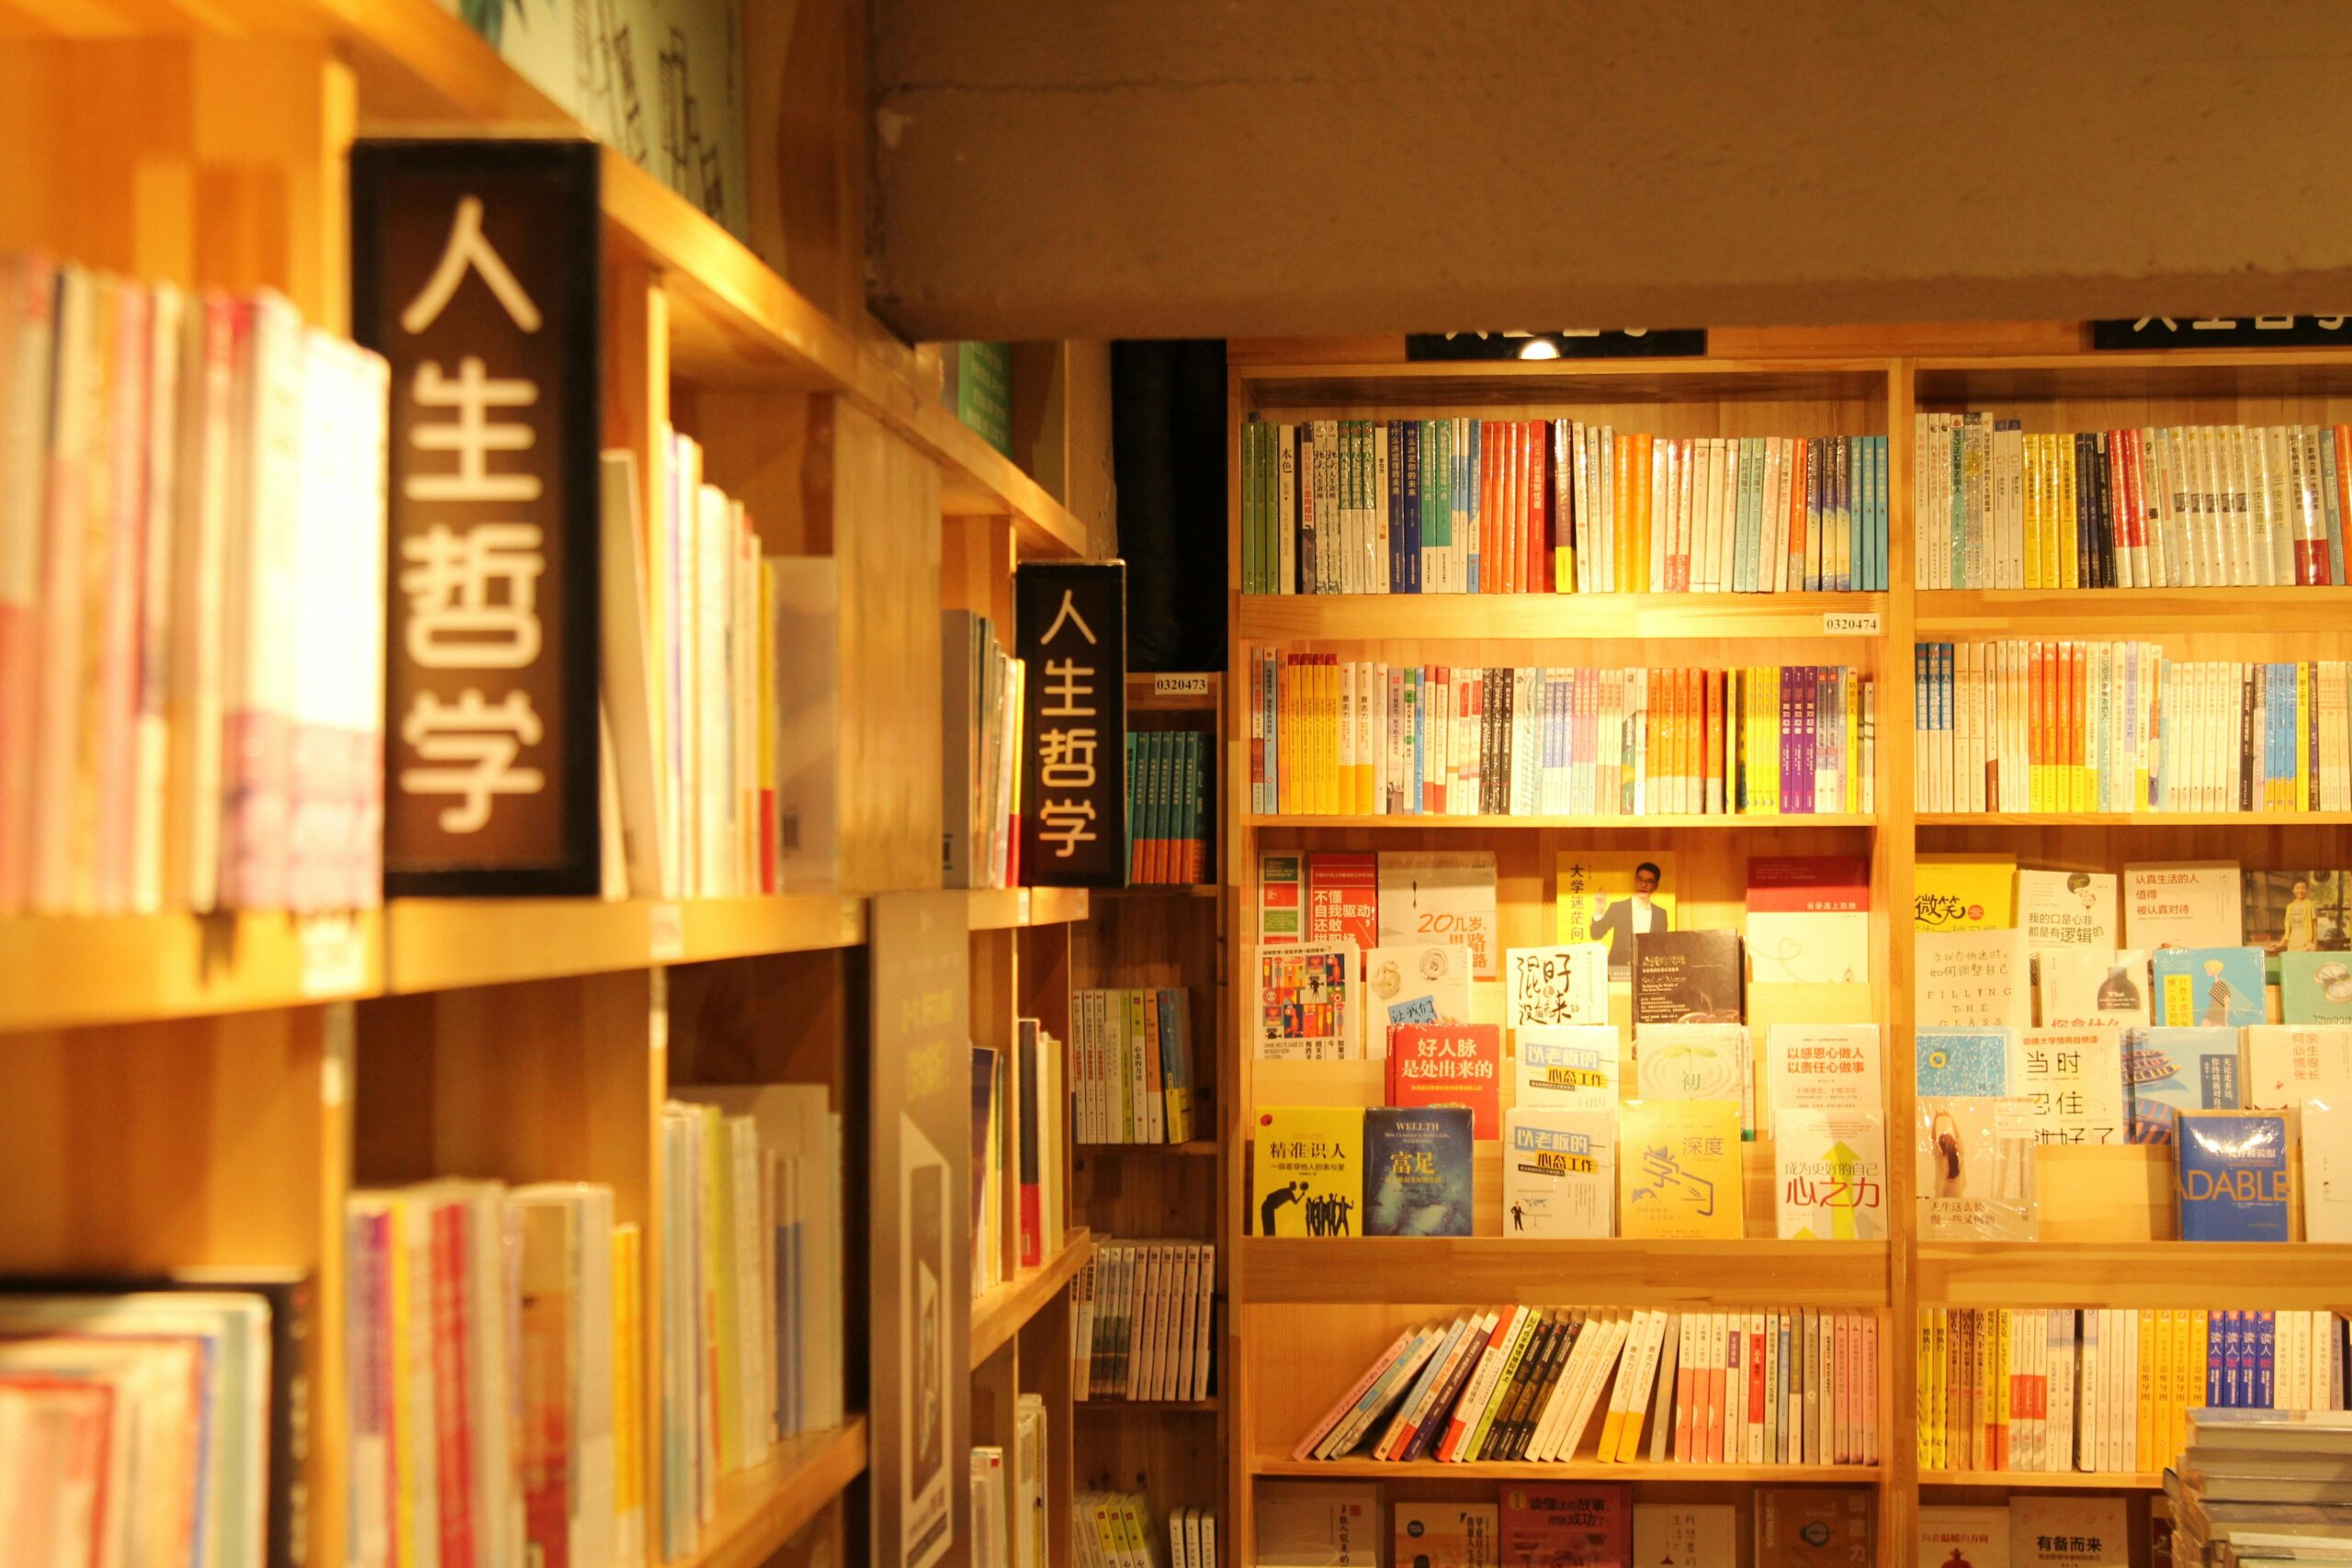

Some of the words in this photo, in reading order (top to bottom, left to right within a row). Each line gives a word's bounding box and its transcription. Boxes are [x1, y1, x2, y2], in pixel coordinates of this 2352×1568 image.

[1282, 448, 1293, 474] 本色
[401, 194, 544, 833] 人生哲学
[1826, 618, 1877, 631] 0320474
[1157, 679, 1206, 691] 0320473
[1039, 589, 1097, 858] 人生哲学
[2136, 874, 2199, 885] 认真生活的人
[1314, 890, 1342, 904] 不懂
[1570, 863, 1585, 944] 大学迷茫问
[2136, 889, 2157, 900] 值得
[1915, 894, 1966, 925] 微笑
[2029, 912, 2094, 925] 我的口是心非
[2137, 905, 2190, 915] 被认真对待
[1314, 919, 1342, 932] 还敢
[2029, 925, 2104, 944] 都是有逻辑的
[1930, 964, 2009, 977] 如何调整自己
[1953, 1003, 1988, 1013] THE
[1418, 1038, 1476, 1058] 好人脉
[1528, 1045, 1598, 1068] 以老板的
[1787, 1046, 1864, 1059] 以感恩心做人
[1401, 1059, 1493, 1079] 是处出来的
[1787, 1062, 1865, 1074] 以责任心做事
[2027, 1051, 2081, 1073] 当时
[1548, 1069, 1603, 1088] 心态工作
[2211, 1057, 2221, 1110] 你终将面对自
[2029, 1091, 2084, 1115] 忍住
[1396, 1122, 1440, 1131] WELLTH
[1517, 1128, 1589, 1154] 以老板的
[1682, 1136, 1724, 1156] 深度
[1390, 1150, 1436, 1176] 富足
[1537, 1153, 1594, 1173] 心态工作
[1785, 1161, 1879, 1177] 成为更好的自己
[1785, 1176, 1880, 1209] 心之力
[2036, 1535, 2102, 1552] 有备而来
